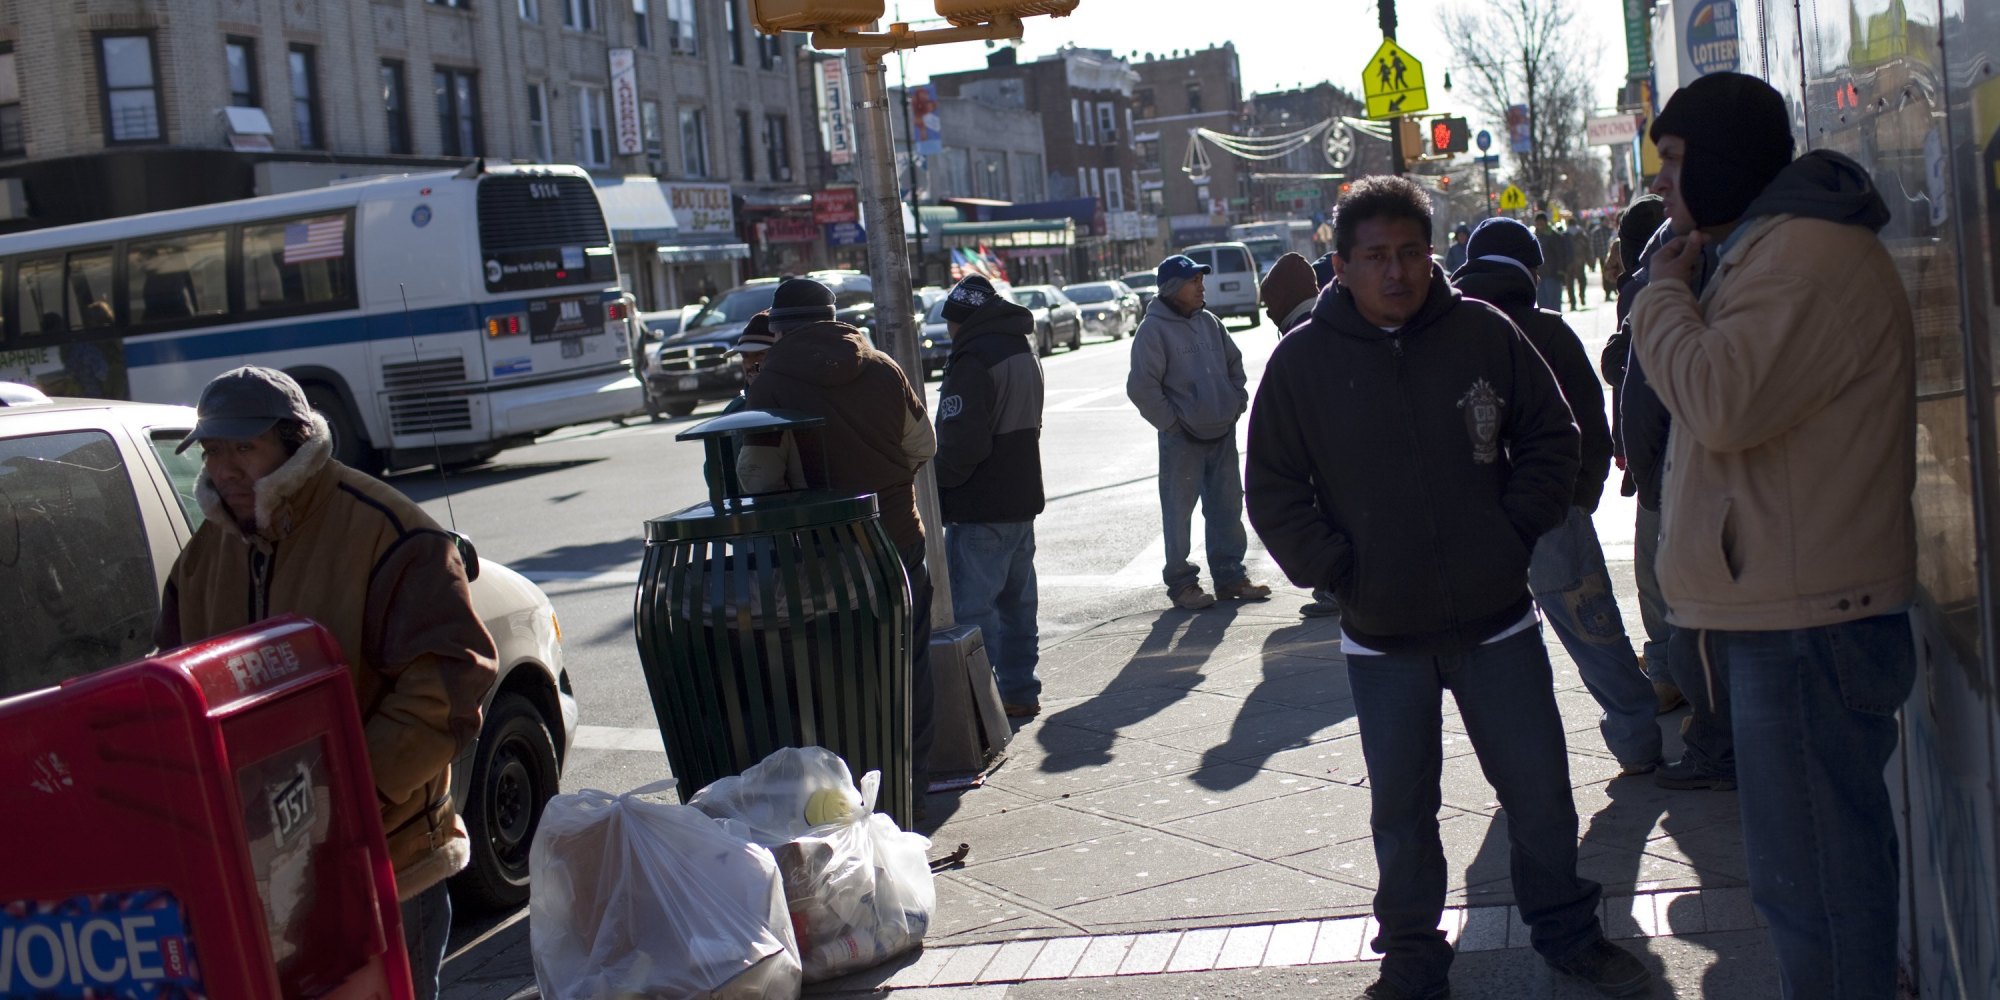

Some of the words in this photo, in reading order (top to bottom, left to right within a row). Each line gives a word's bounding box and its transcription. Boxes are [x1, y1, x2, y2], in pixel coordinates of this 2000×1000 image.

[1713, 2, 1731, 19] NEW
[1714, 19, 1735, 36] YORK
[529, 183, 560, 199] 5114
[672, 187, 729, 209] BOUTIQUE
[503, 264, 518, 274] New
[519, 263, 533, 273] York
[533, 261, 546, 273] City
[546, 260, 558, 270] Bus
[228, 642, 299, 693] FREE
